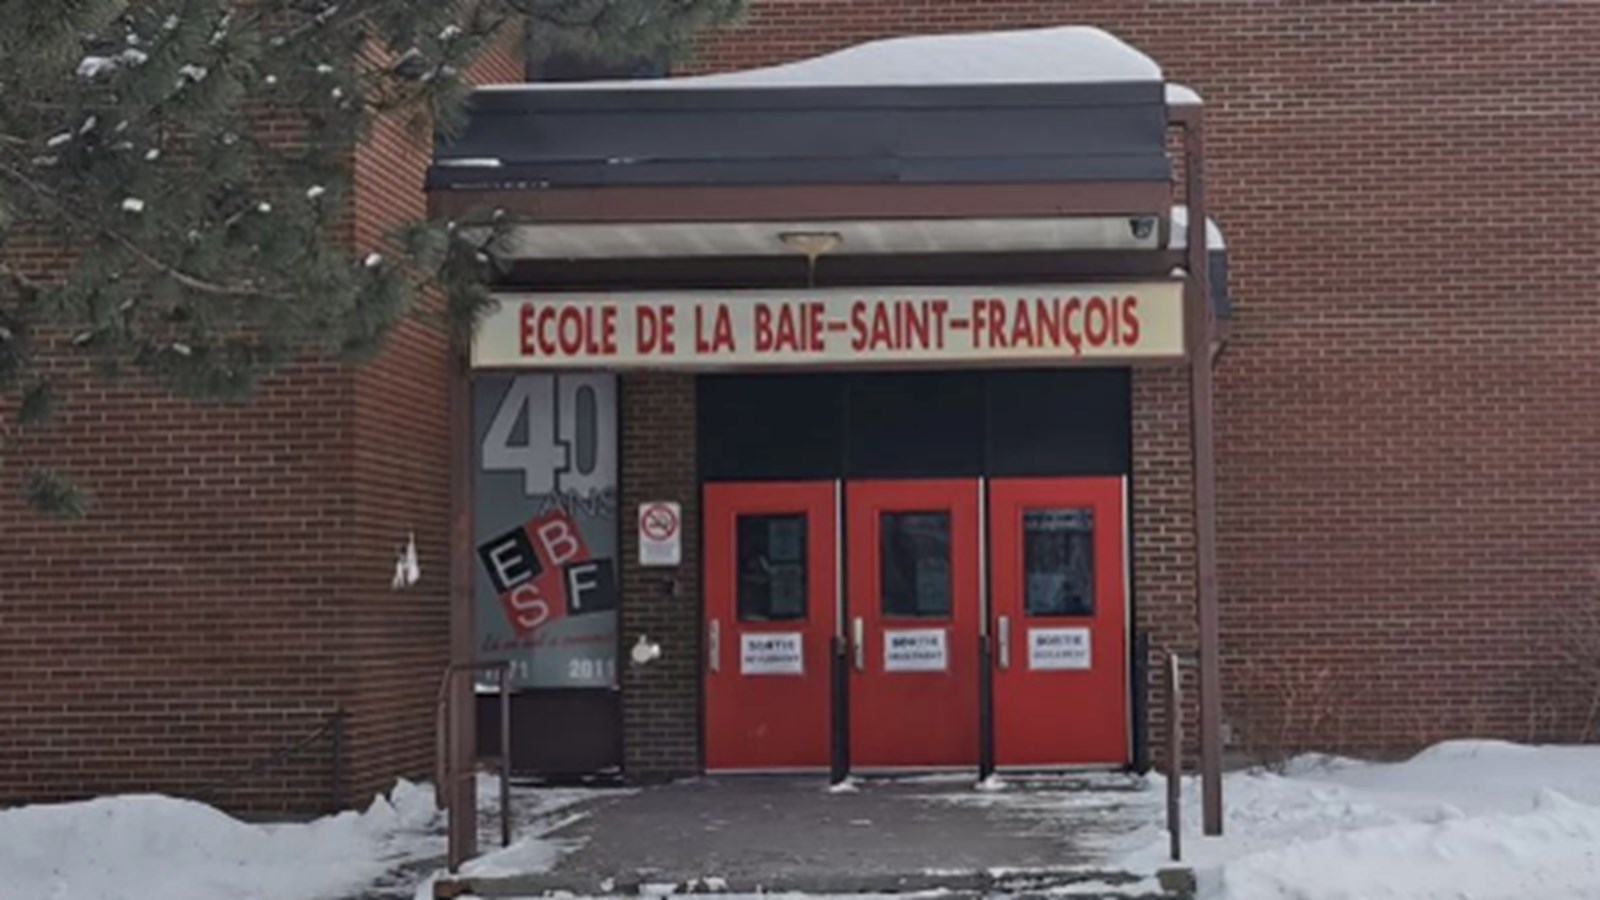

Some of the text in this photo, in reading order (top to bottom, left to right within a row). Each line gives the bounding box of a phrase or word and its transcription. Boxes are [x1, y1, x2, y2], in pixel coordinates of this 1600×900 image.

[519, 301, 618, 356] ÉCOLE
[636, 305, 676, 354] DE
[695, 303, 735, 353] LA
[482, 374, 617, 497] 40
